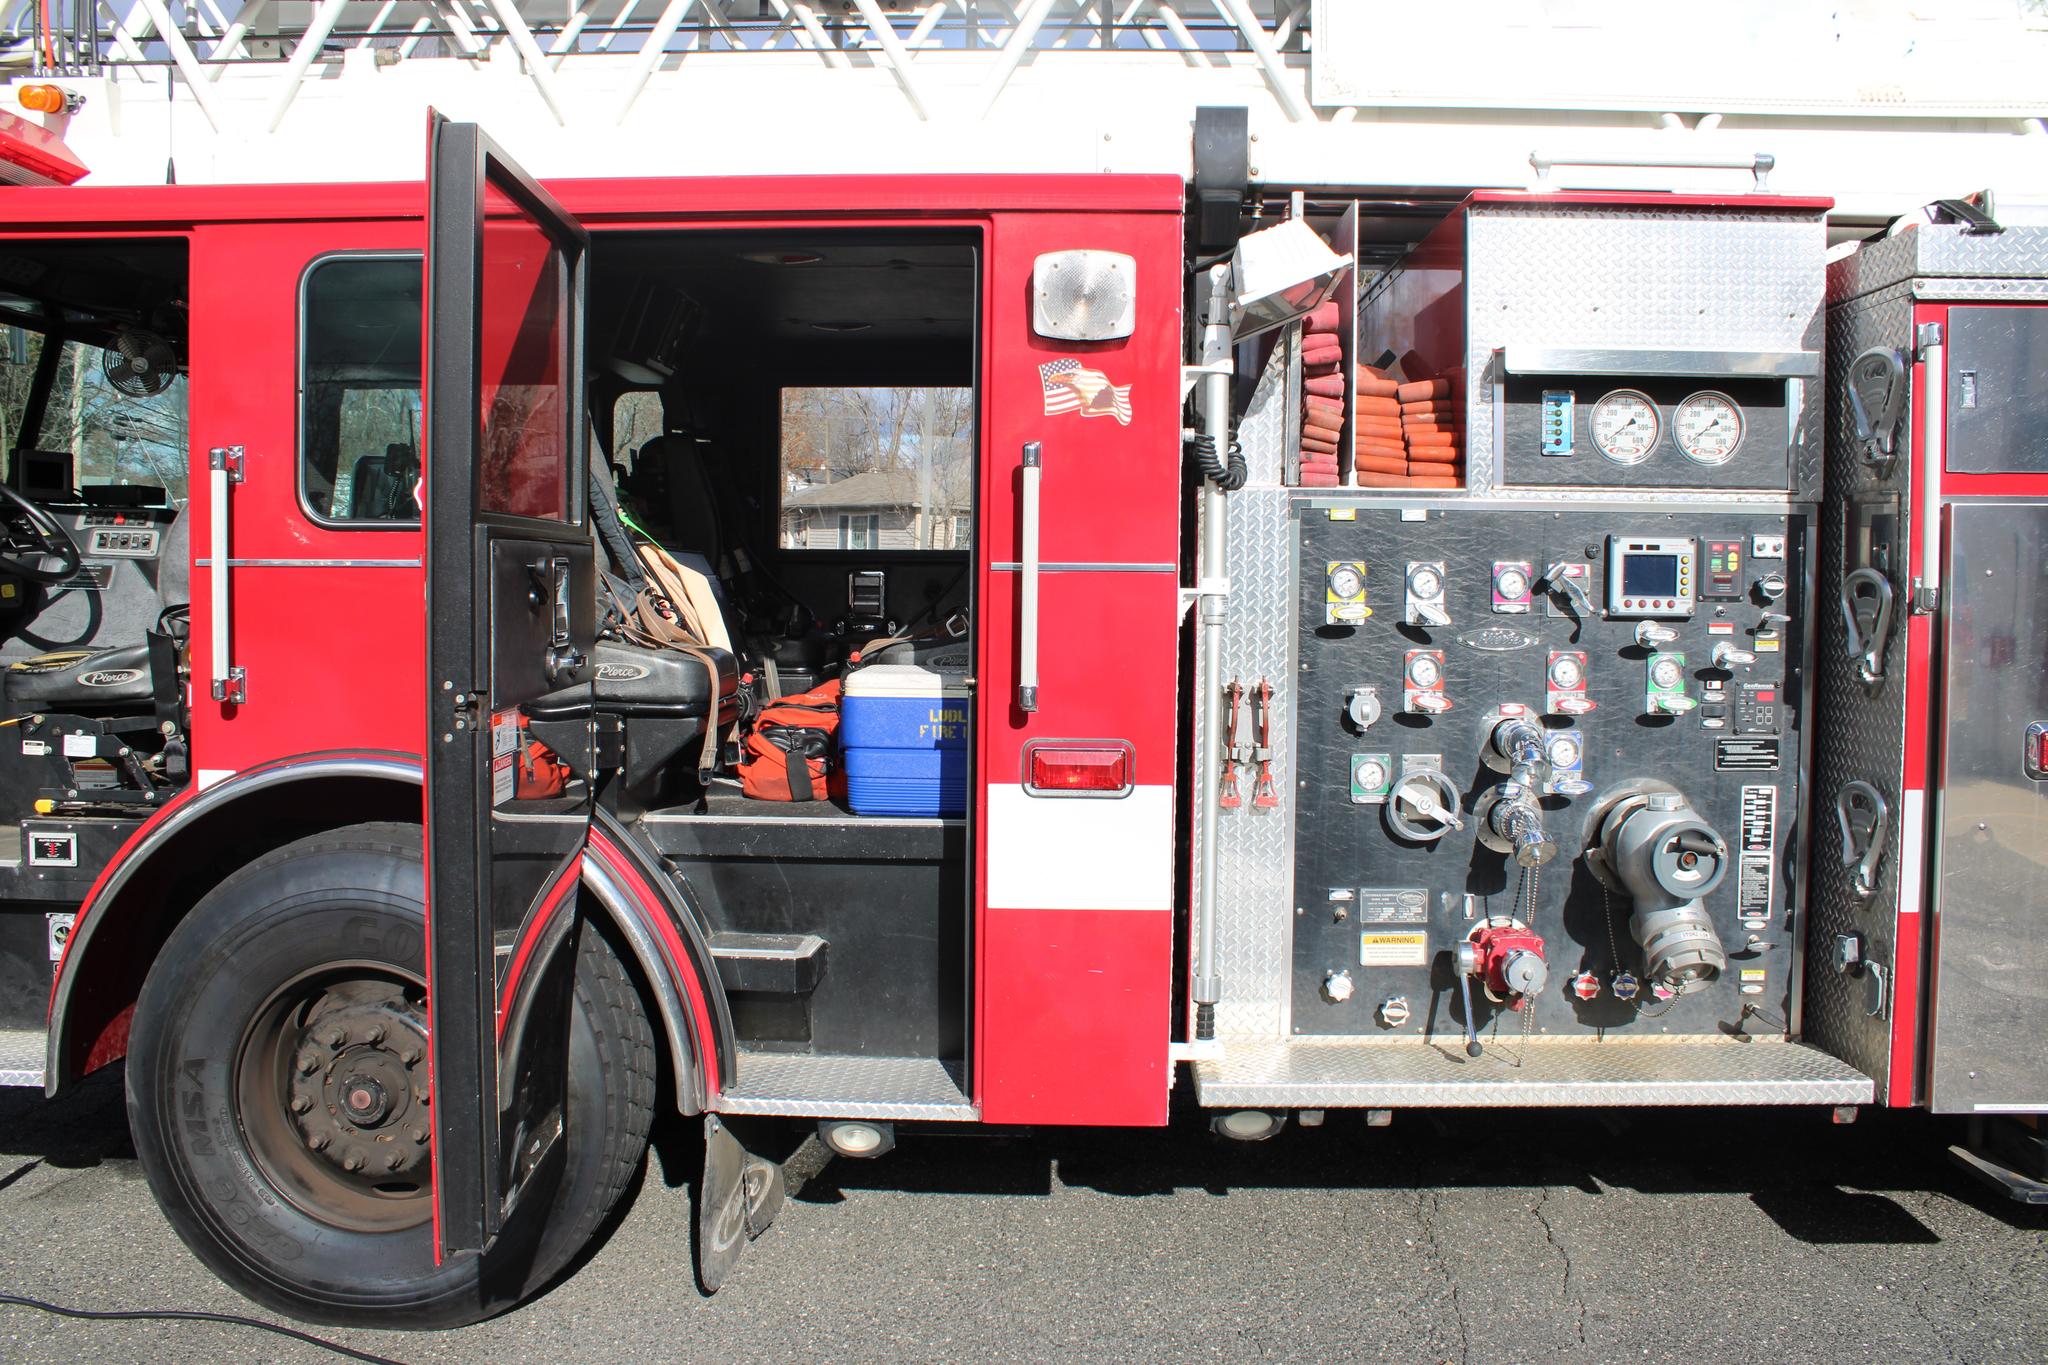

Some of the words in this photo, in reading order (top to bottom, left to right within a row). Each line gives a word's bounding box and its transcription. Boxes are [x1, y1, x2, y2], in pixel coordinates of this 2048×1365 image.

[91, 669, 130, 685] Pierce
[597, 663, 635, 679] Pierce
[919, 725, 957, 738] FIRE
[1379, 936, 1416, 944] WARNING
